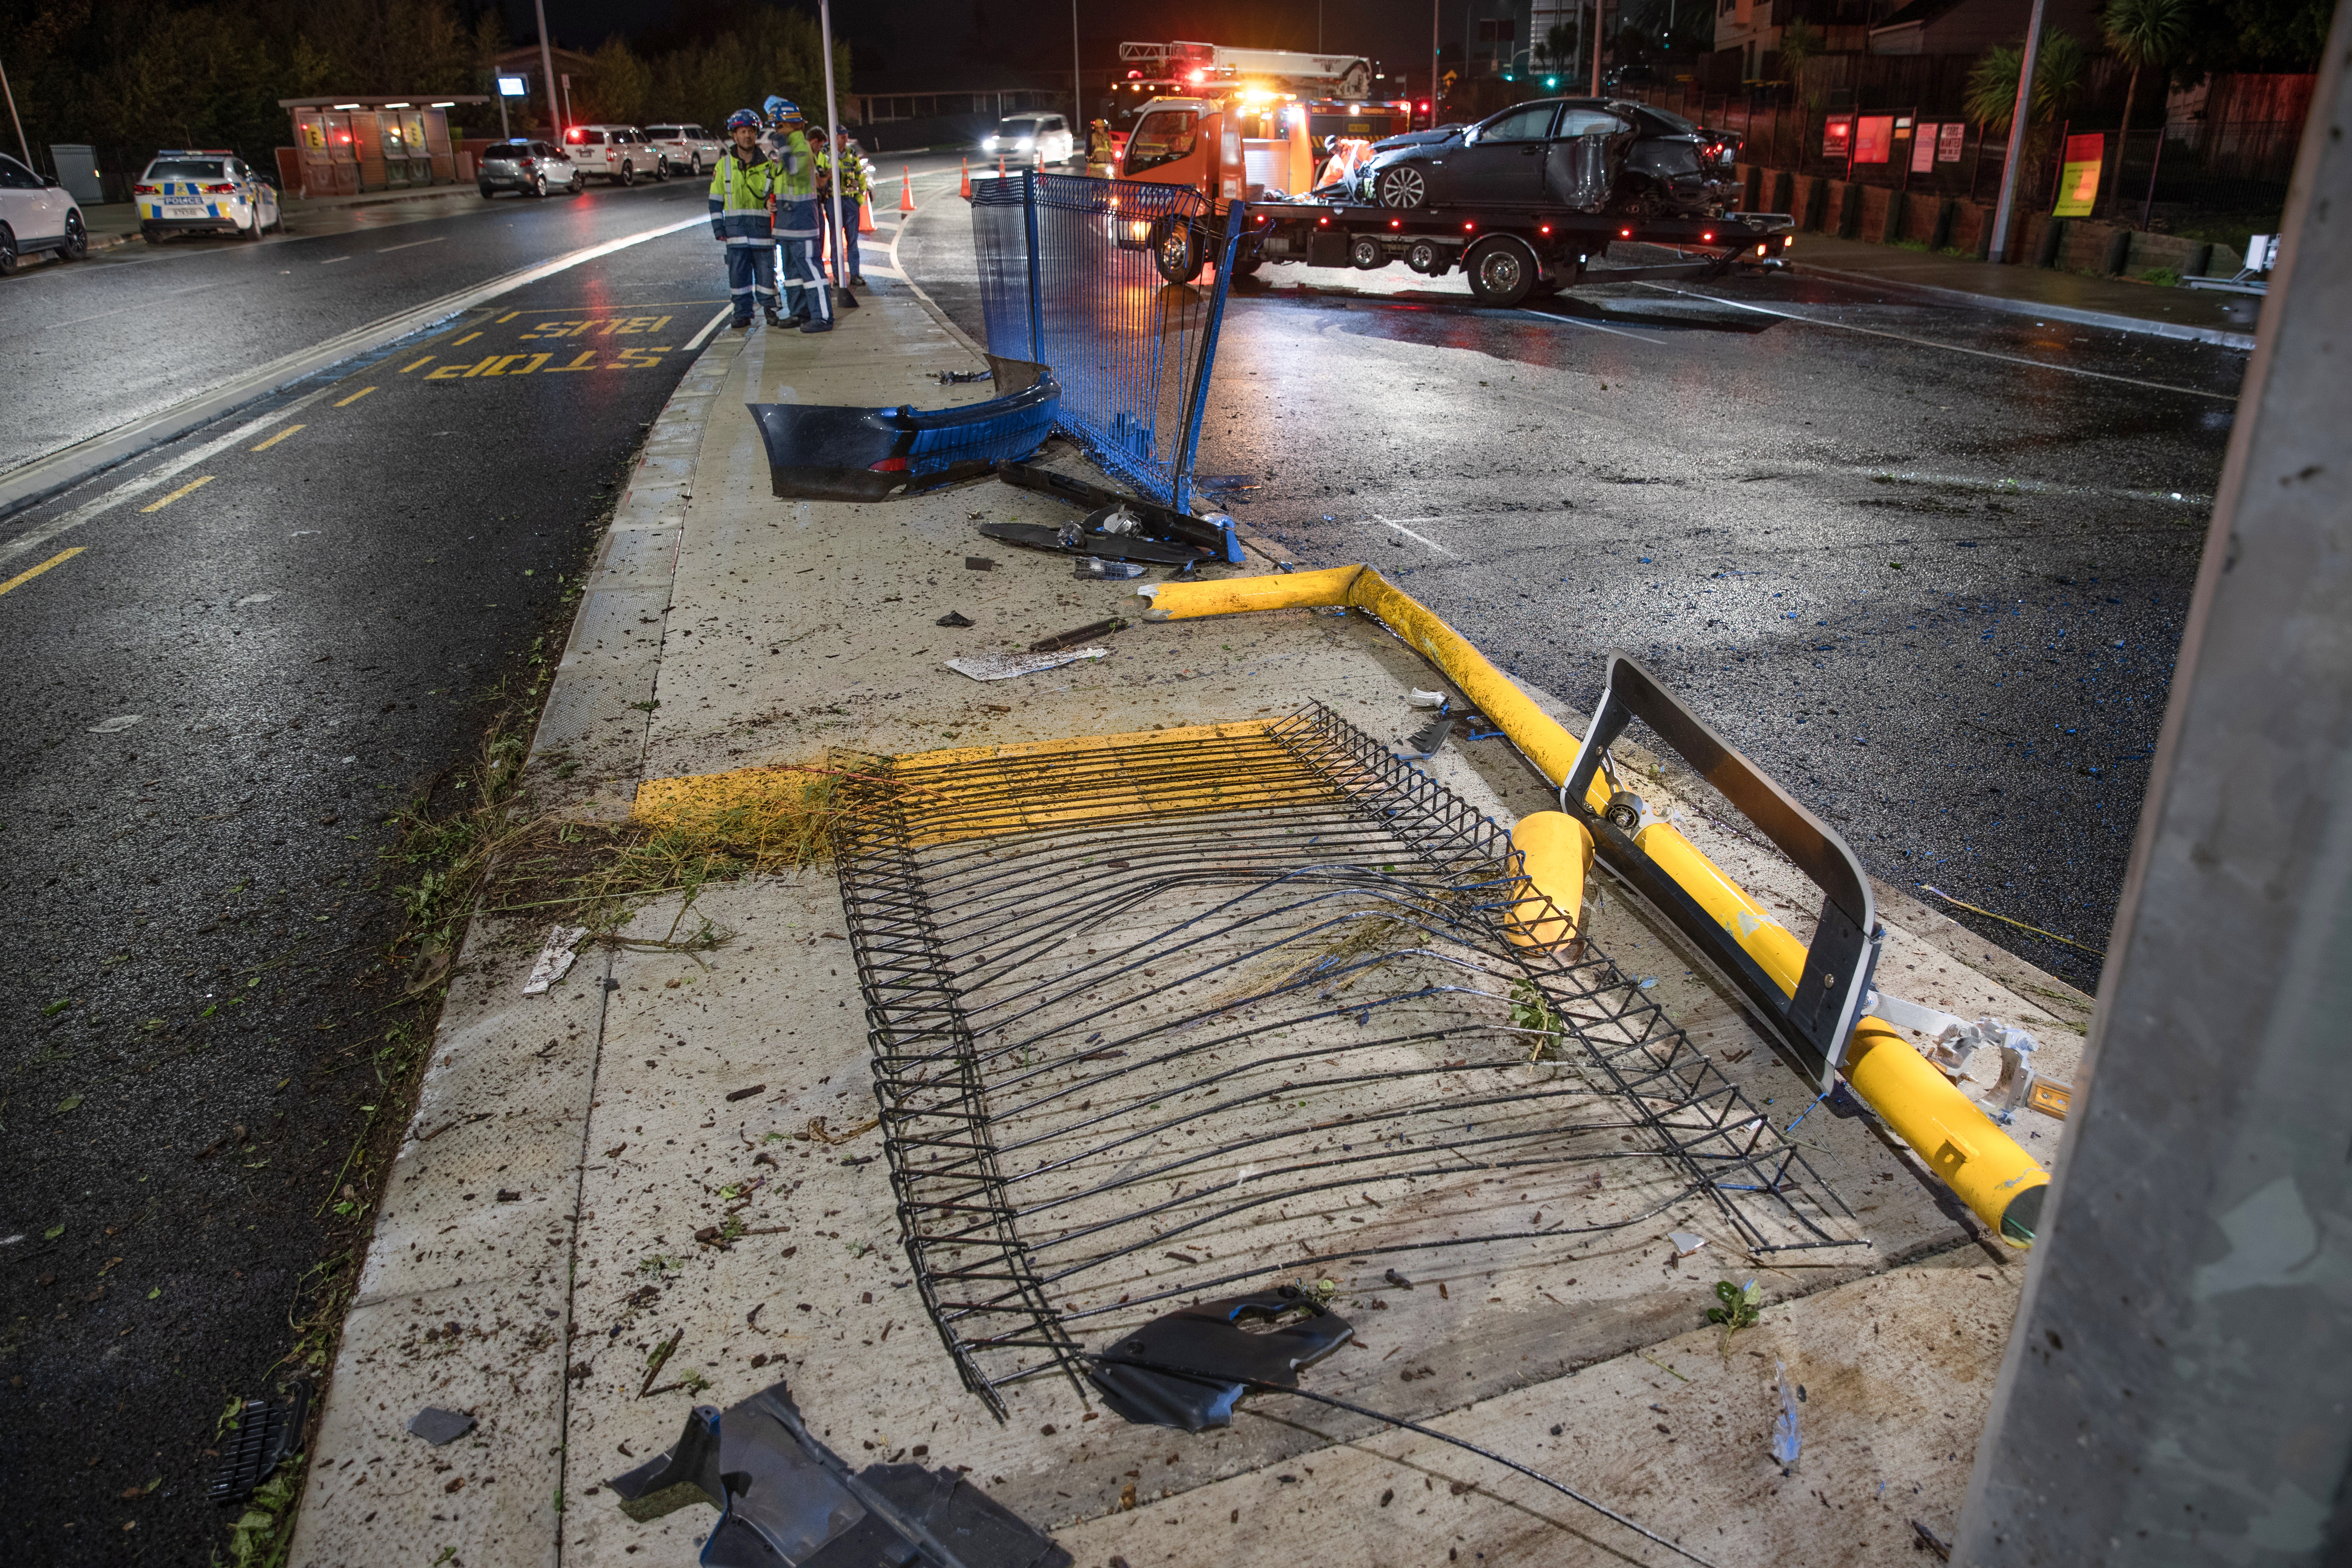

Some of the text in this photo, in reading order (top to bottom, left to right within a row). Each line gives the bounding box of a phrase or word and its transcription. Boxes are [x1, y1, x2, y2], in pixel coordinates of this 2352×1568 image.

[311, 131, 319, 146] E
[519, 315, 673, 340] BUS
[423, 346, 673, 380] STOP
